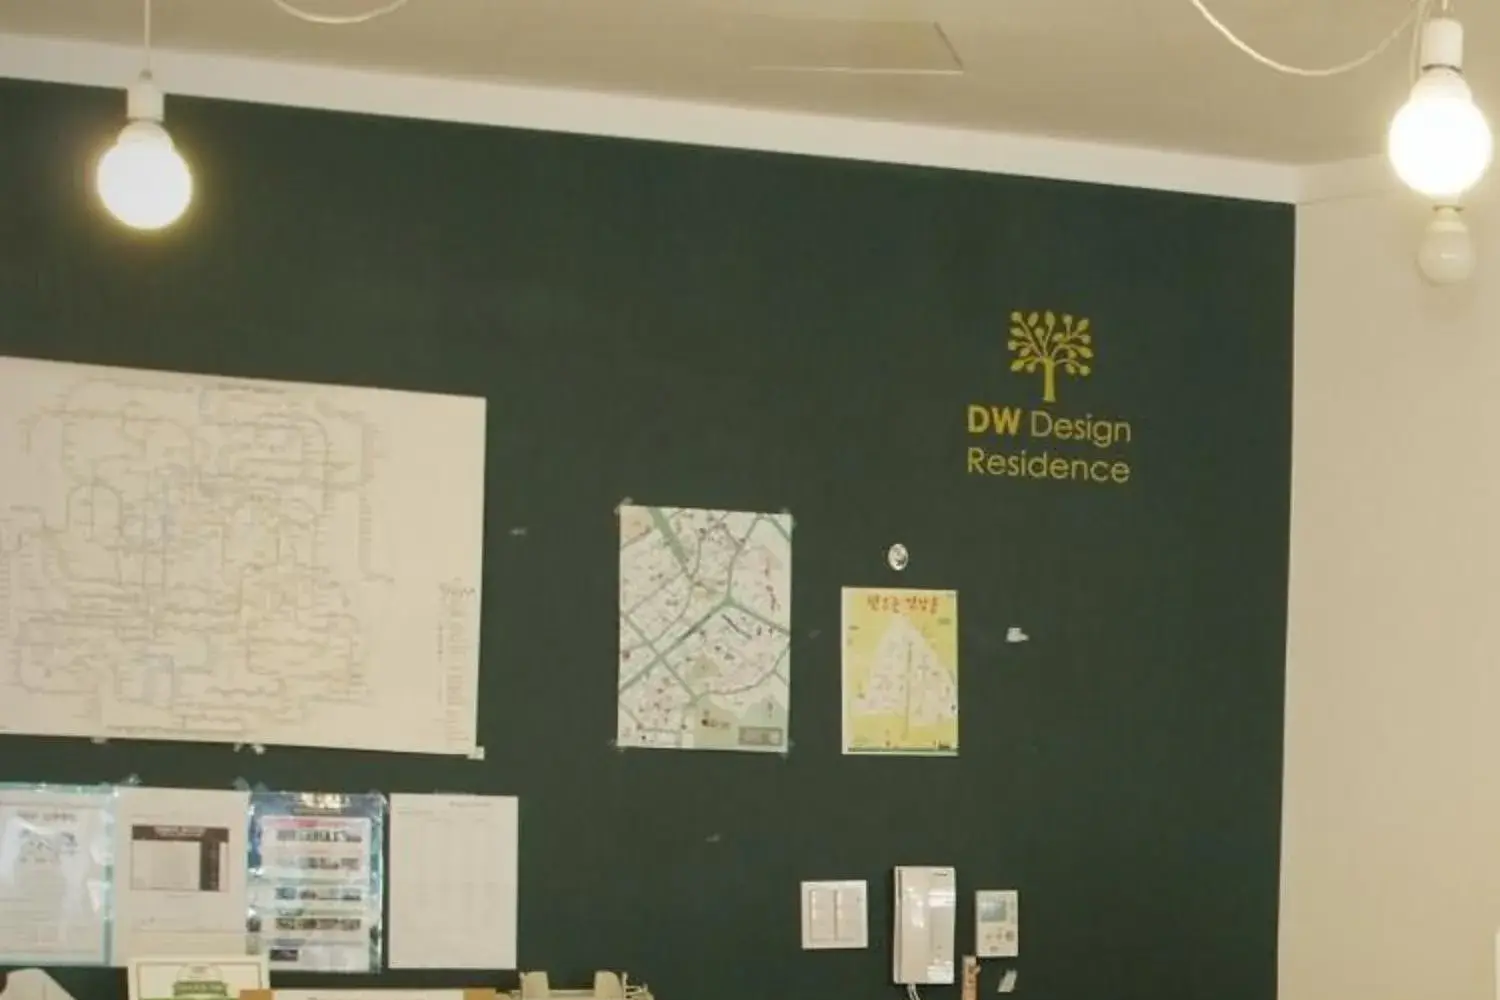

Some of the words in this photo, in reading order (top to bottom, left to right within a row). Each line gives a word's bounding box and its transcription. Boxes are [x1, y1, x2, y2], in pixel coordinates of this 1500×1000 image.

[967, 405, 1021, 436] DW
[1031, 410, 1132, 448] Design
[967, 447, 1131, 484] Residence
